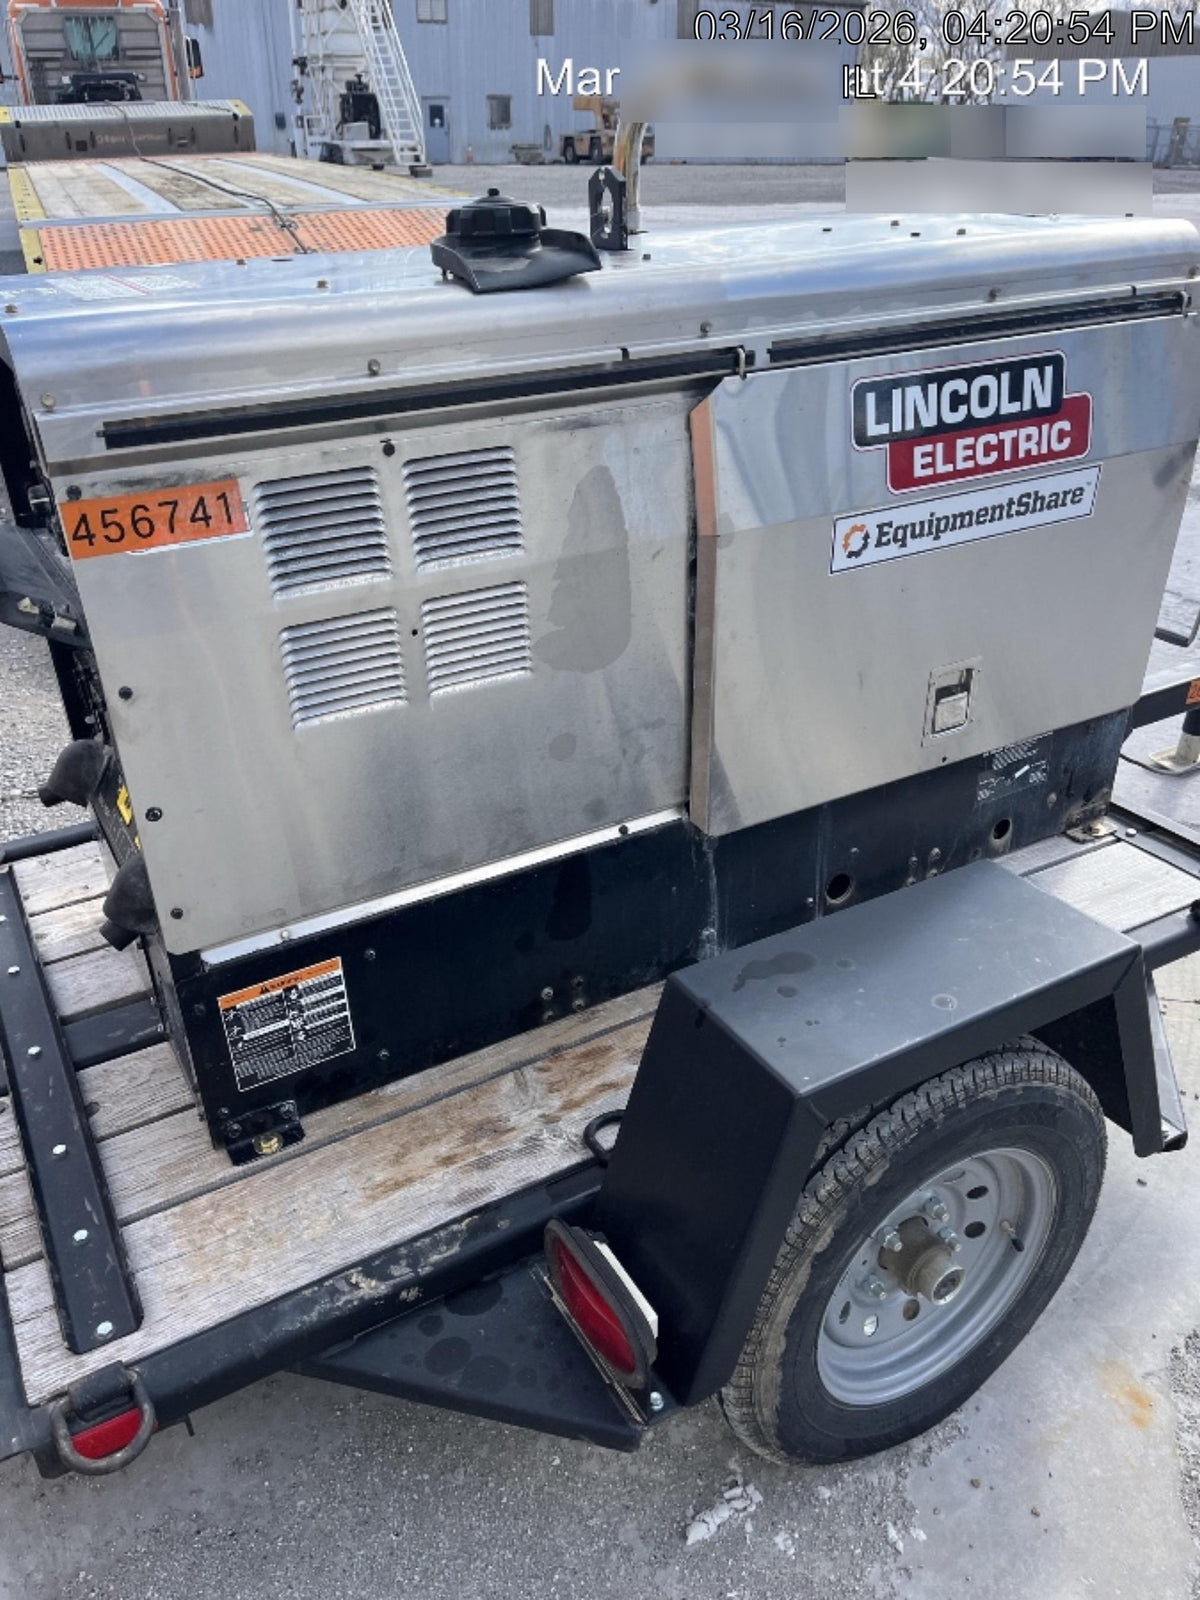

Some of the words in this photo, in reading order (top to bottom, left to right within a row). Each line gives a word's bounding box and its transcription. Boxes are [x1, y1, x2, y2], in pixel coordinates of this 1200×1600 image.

[865, 364, 1054, 437] LINCOLN
[913, 420, 1072, 479] ELECTRIC
[72, 491, 233, 547] 456741
[874, 484, 1085, 549] EquipmentShare
